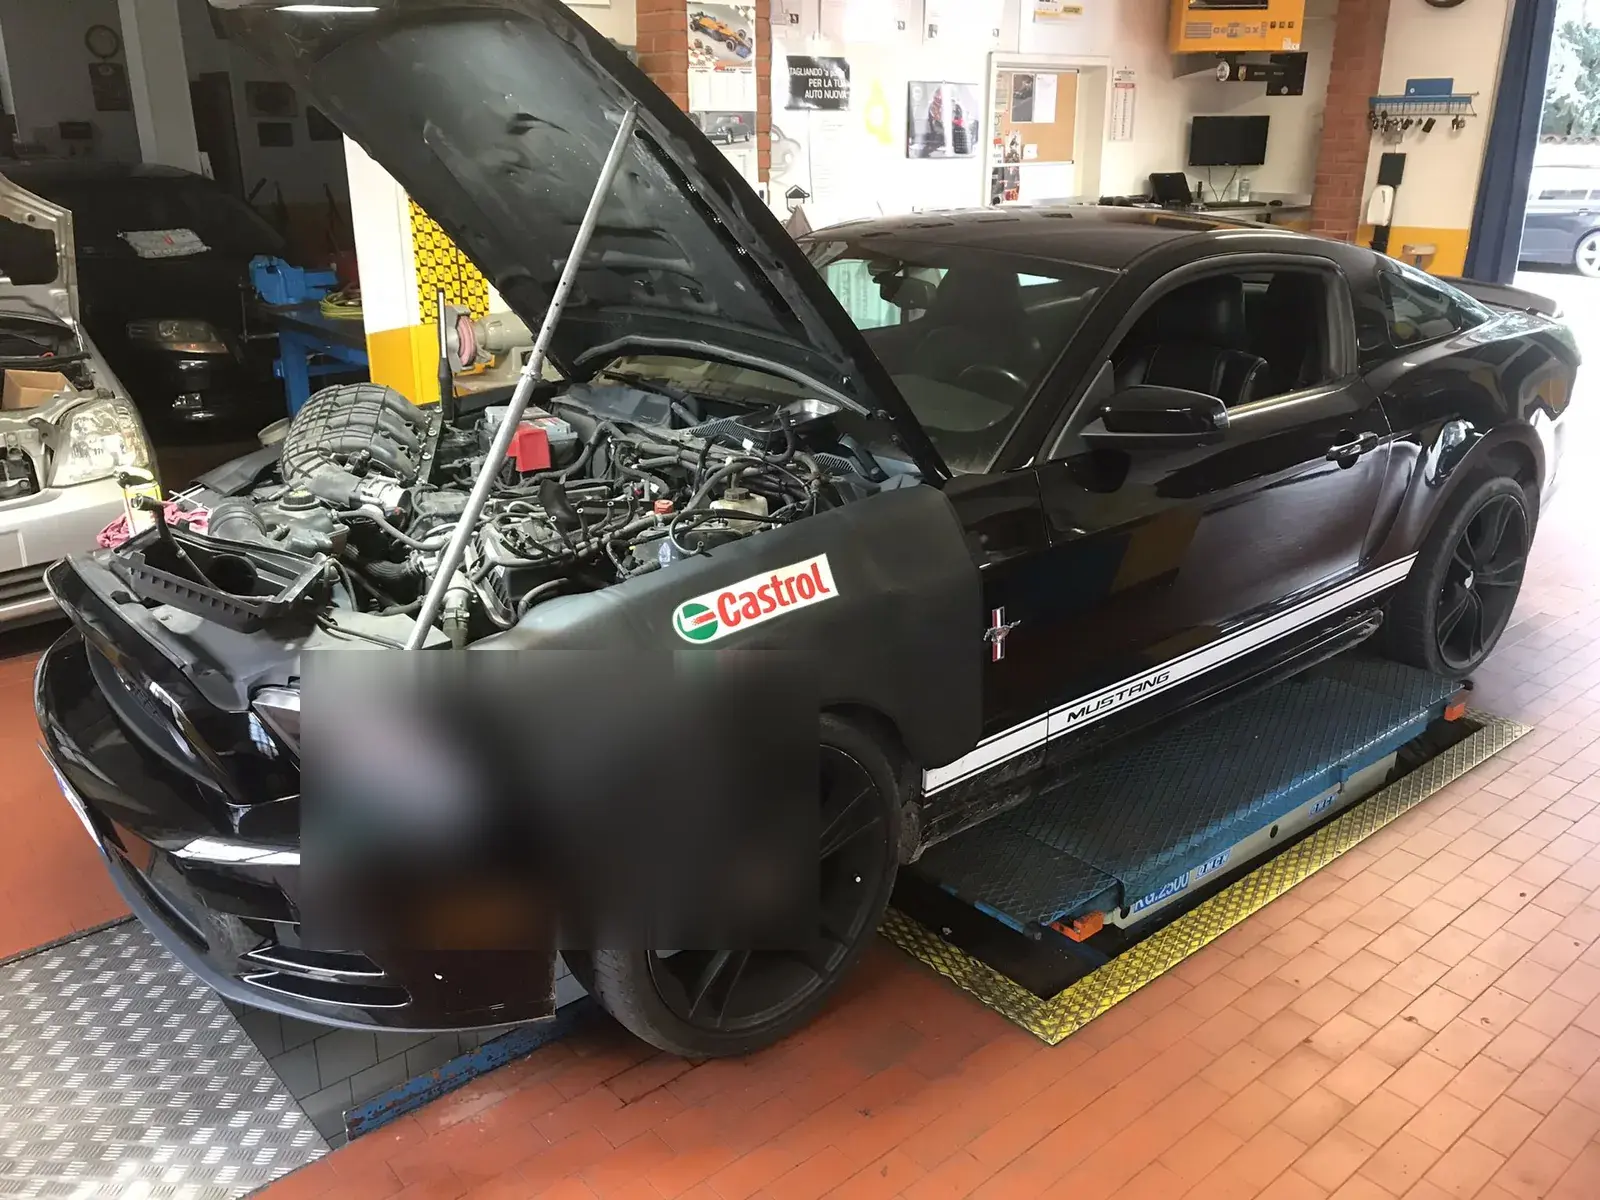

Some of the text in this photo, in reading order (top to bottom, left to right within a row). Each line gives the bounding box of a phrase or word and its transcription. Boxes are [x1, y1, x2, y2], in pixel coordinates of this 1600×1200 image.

[789, 67, 823, 76] TAGLIANDO
[808, 78, 822, 87] PER
[823, 79, 832, 87] LA
[804, 89, 847, 99] AUTO NUOVA
[717, 562, 830, 627] Castrol
[1067, 671, 1170, 722] MUSTANG
